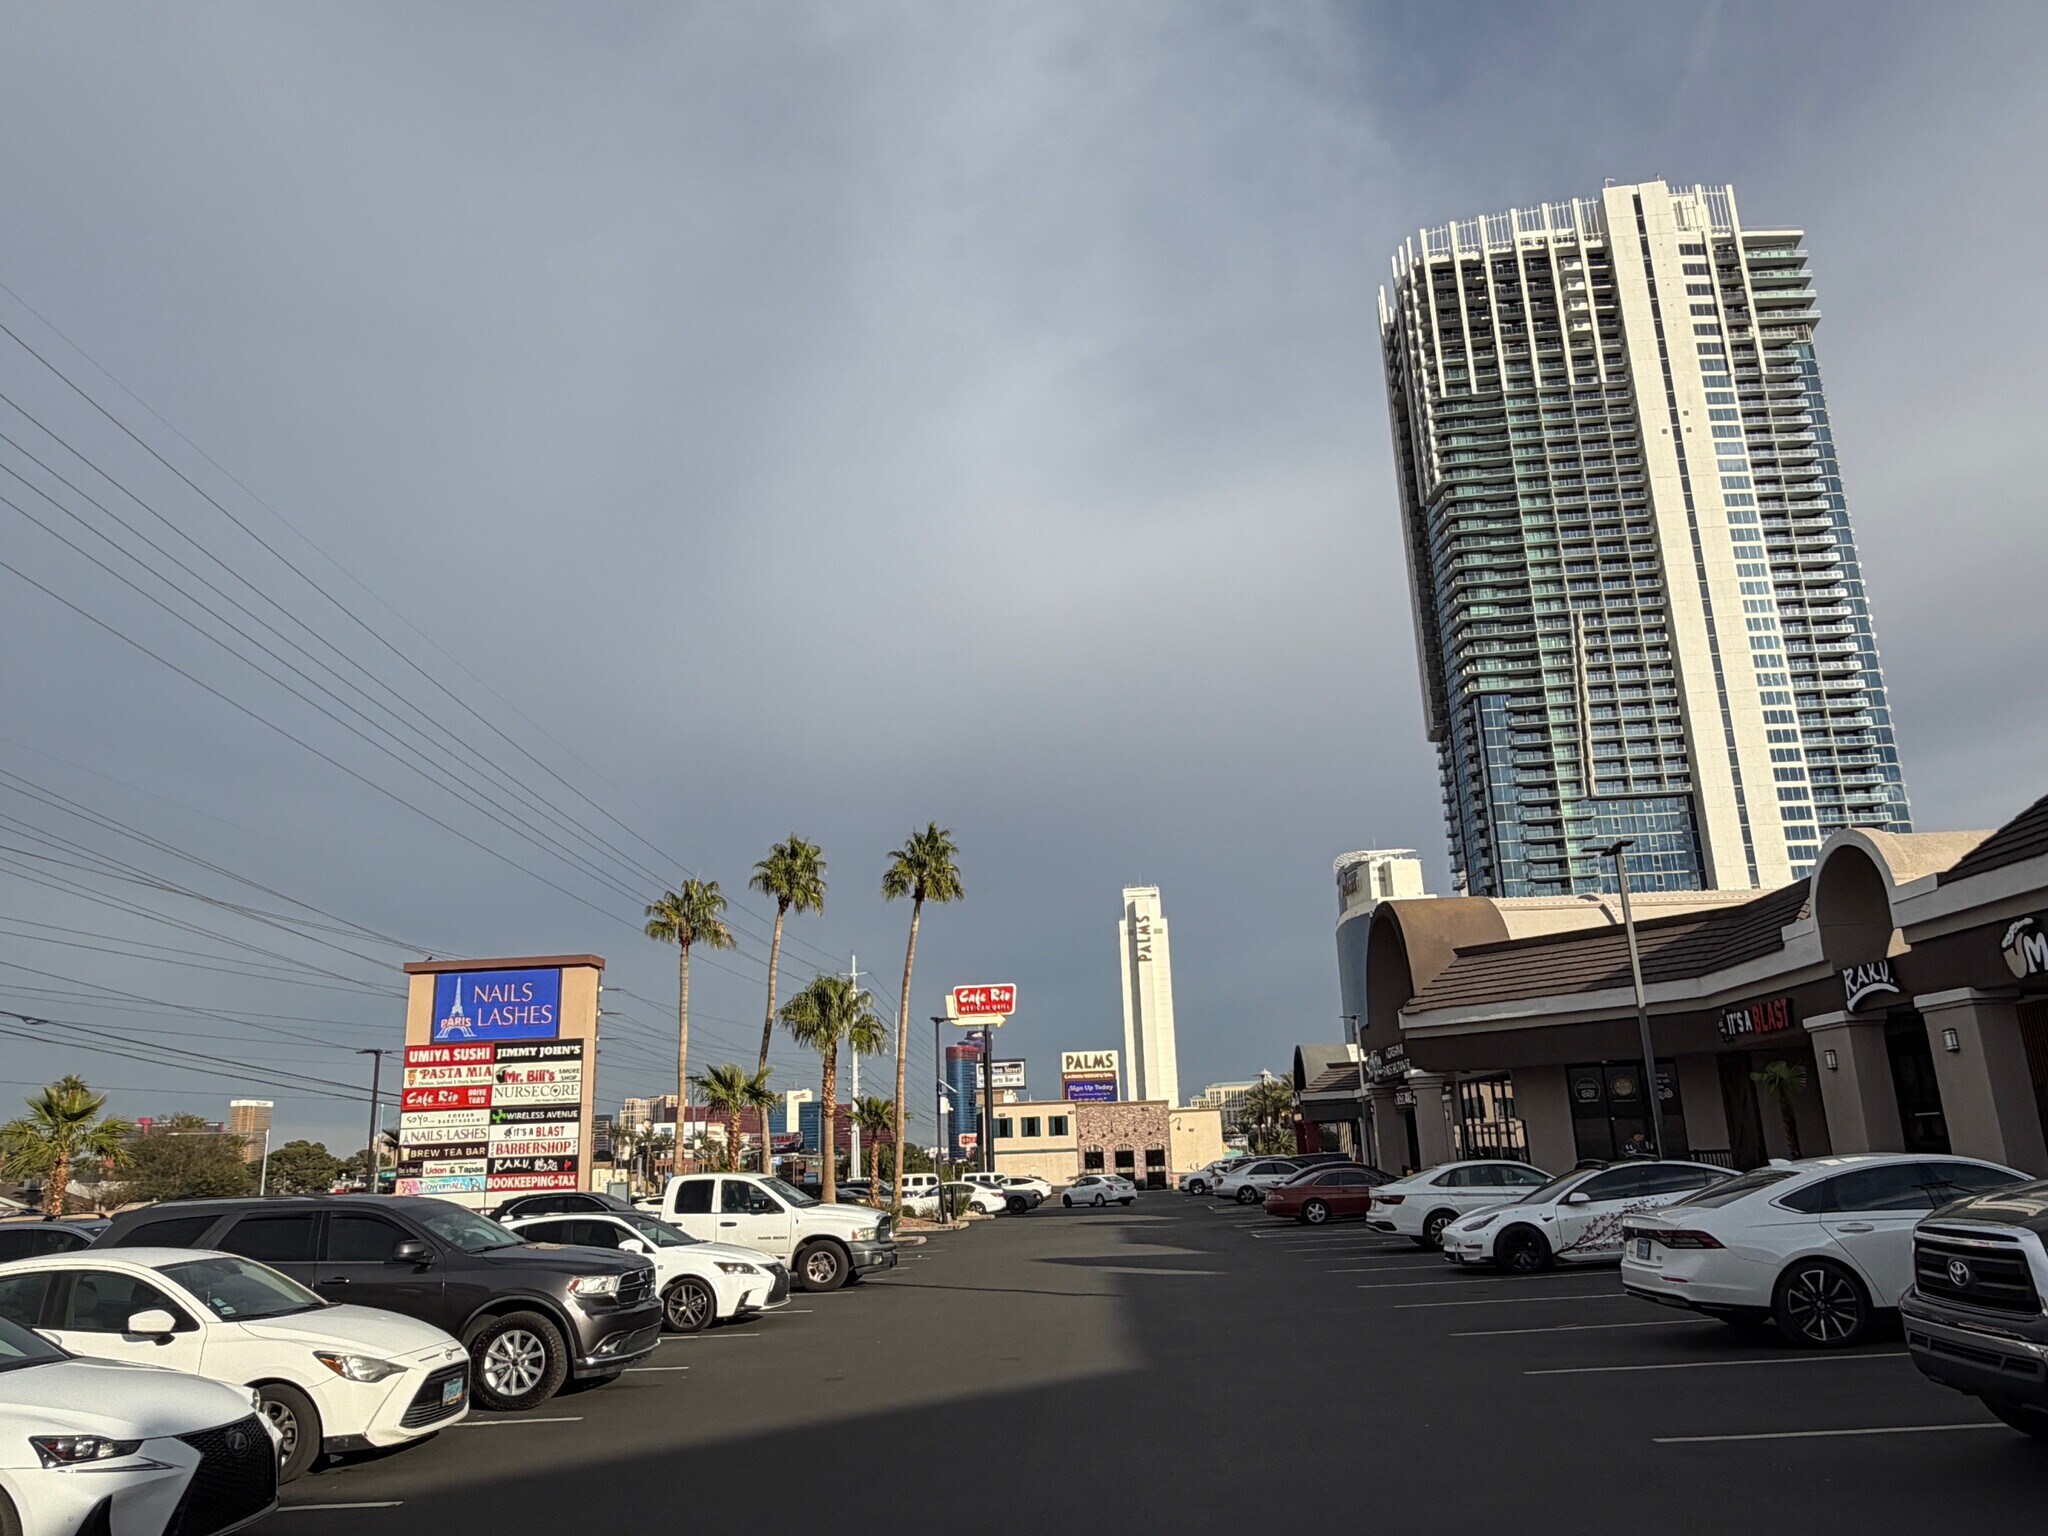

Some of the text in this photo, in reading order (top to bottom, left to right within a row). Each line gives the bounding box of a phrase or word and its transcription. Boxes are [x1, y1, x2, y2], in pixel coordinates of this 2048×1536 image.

[1136, 915, 1152, 962] PALMS
[473, 982, 533, 1003] NAILS
[990, 988, 1011, 1002] Rio
[477, 1004, 552, 1027] LASHES
[1744, 1009, 1752, 1031] A
[1752, 998, 1789, 1034] BLAST
[440, 1017, 472, 1029] PARIS
[409, 1047, 491, 1063] UMIYA SUSHI
[496, 1045, 581, 1060] JIMMY JOHN'S
[1065, 1053, 1114, 1070] PALMS
[420, 1066, 492, 1079] PASTA MIA
[503, 1069, 555, 1083] Mr. Bill's
[438, 1090, 459, 1103] Rio
[506, 1110, 579, 1120] WIRELESS AVENUE
[411, 1128, 487, 1142] NAILS LASHES
[528, 1128, 534, 1136] A
[536, 1126, 565, 1137] BLAST
[410, 1147, 486, 1158] BREW TEA BAR
[495, 1141, 572, 1156] BARBERSHOP
[425, 1167, 447, 1175] Udon
[449, 1166, 456, 1174] &
[458, 1166, 485, 1174] Tapas
